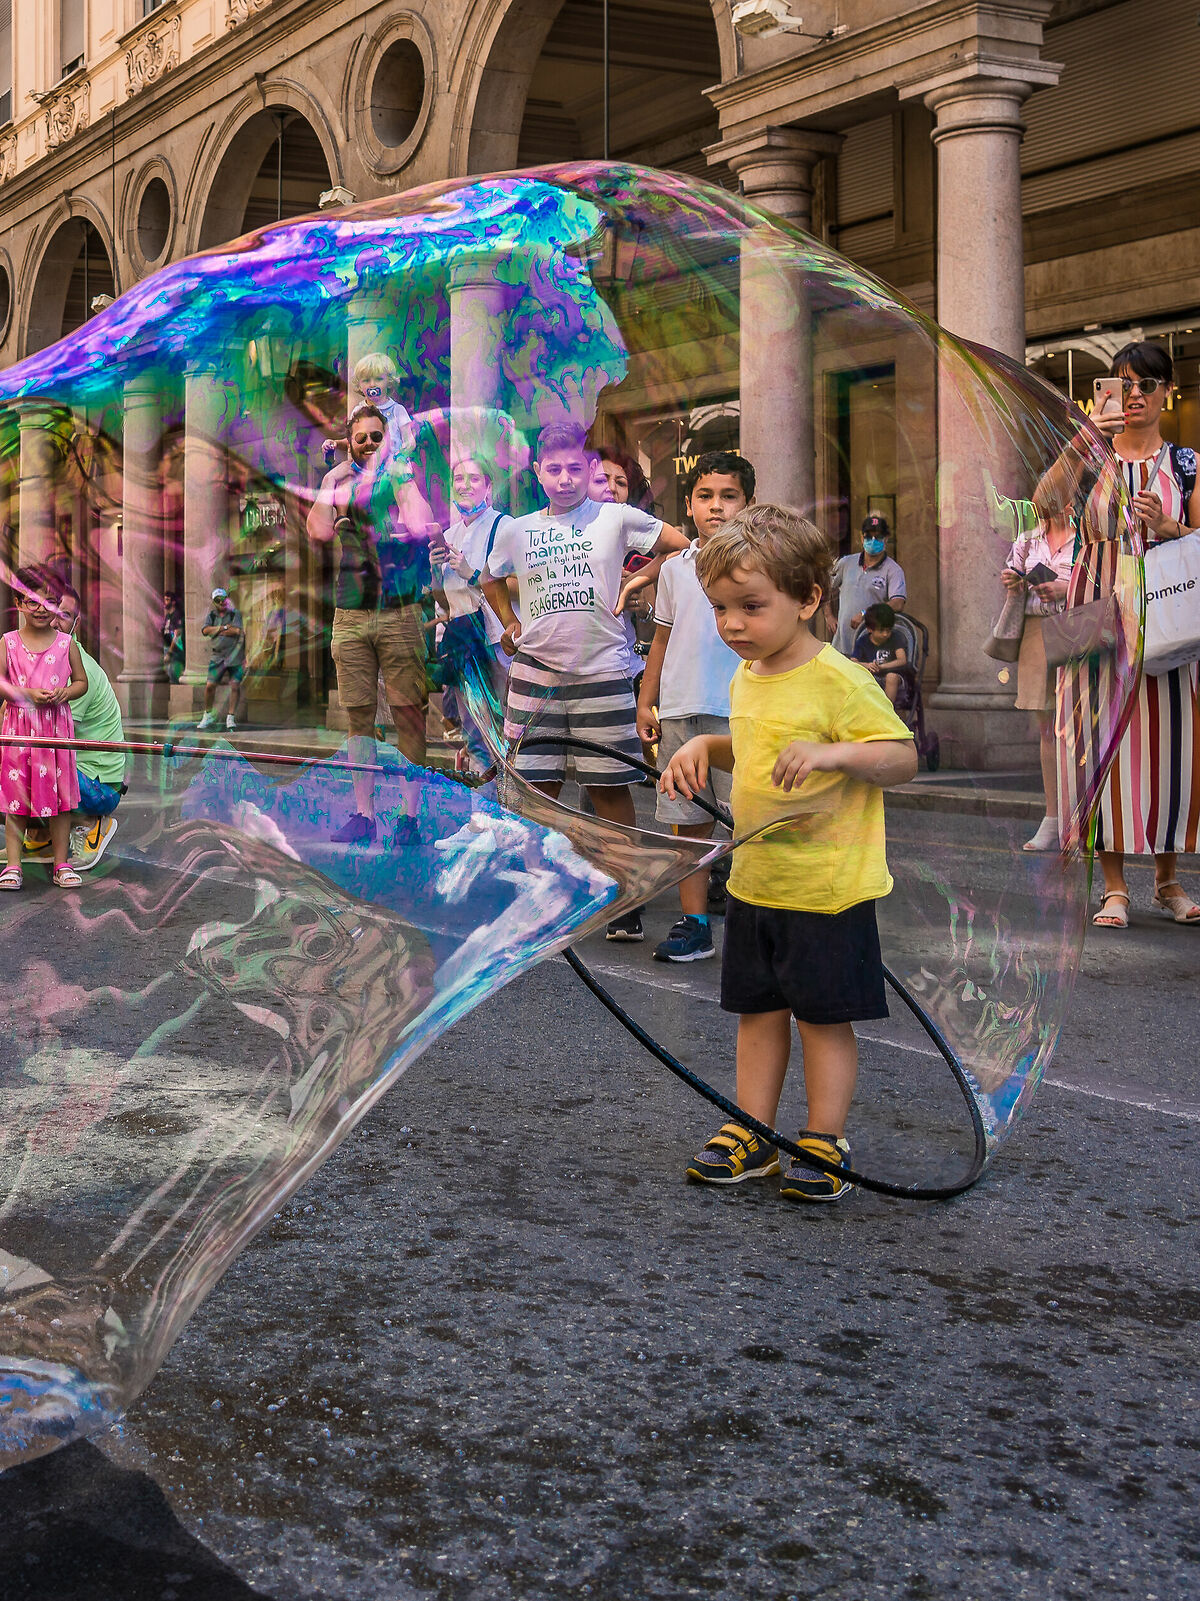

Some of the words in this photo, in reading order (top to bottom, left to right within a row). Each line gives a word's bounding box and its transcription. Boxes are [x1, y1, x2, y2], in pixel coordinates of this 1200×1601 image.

[525, 527, 565, 548] Tutte
[571, 524, 584, 539] le
[525, 540, 594, 562] mamme
[554, 554, 570, 566] figli
[572, 552, 589, 561] belli
[527, 573, 543, 587] ma
[546, 566, 557, 580] la
[563, 562, 594, 578] MIA
[549, 580, 581, 593] proprio
[530, 586, 595, 617] ESAGERATO!
